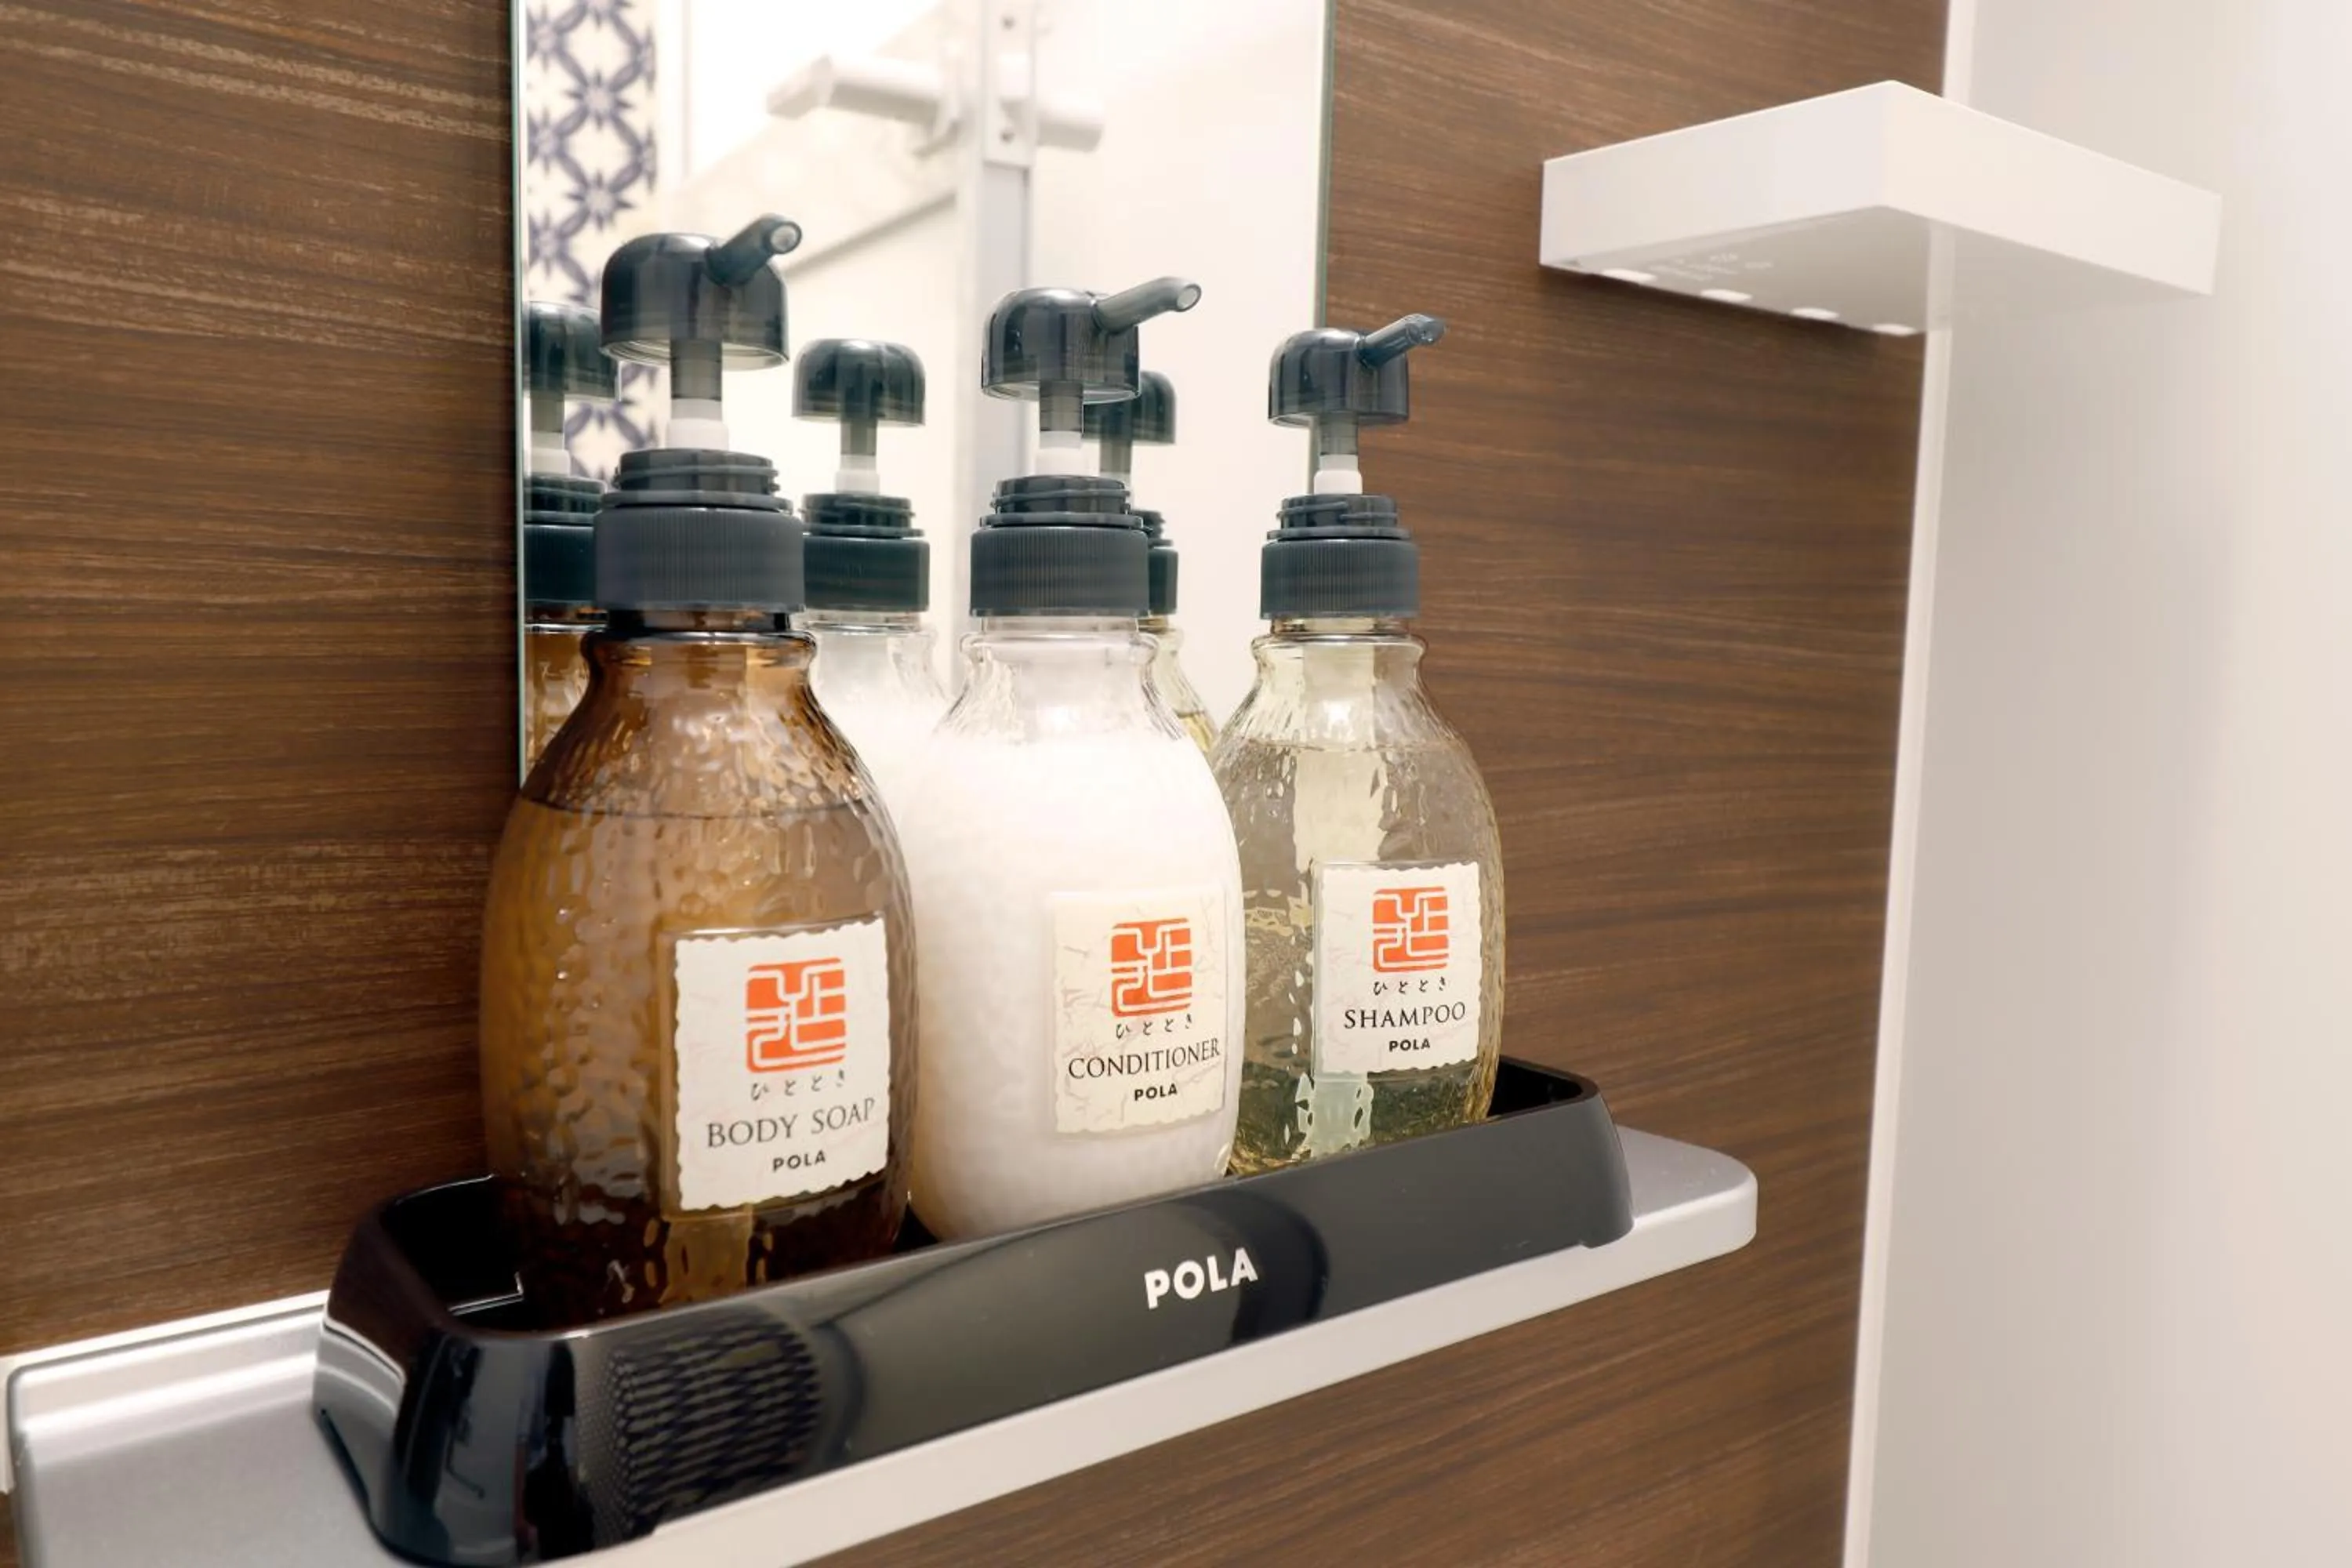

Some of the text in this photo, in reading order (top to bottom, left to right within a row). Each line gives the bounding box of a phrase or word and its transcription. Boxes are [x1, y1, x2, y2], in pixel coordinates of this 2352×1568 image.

[1344, 1001, 1466, 1029] SHAMPOO
[1068, 1037, 1221, 1080] CONDITIONER
[1388, 1038, 1431, 1052] POLA
[1134, 1083, 1178, 1101] POLA
[707, 1097, 876, 1148] BODY SOAP
[772, 1149, 826, 1172] POLA
[1144, 1247, 1258, 1309] POLA
